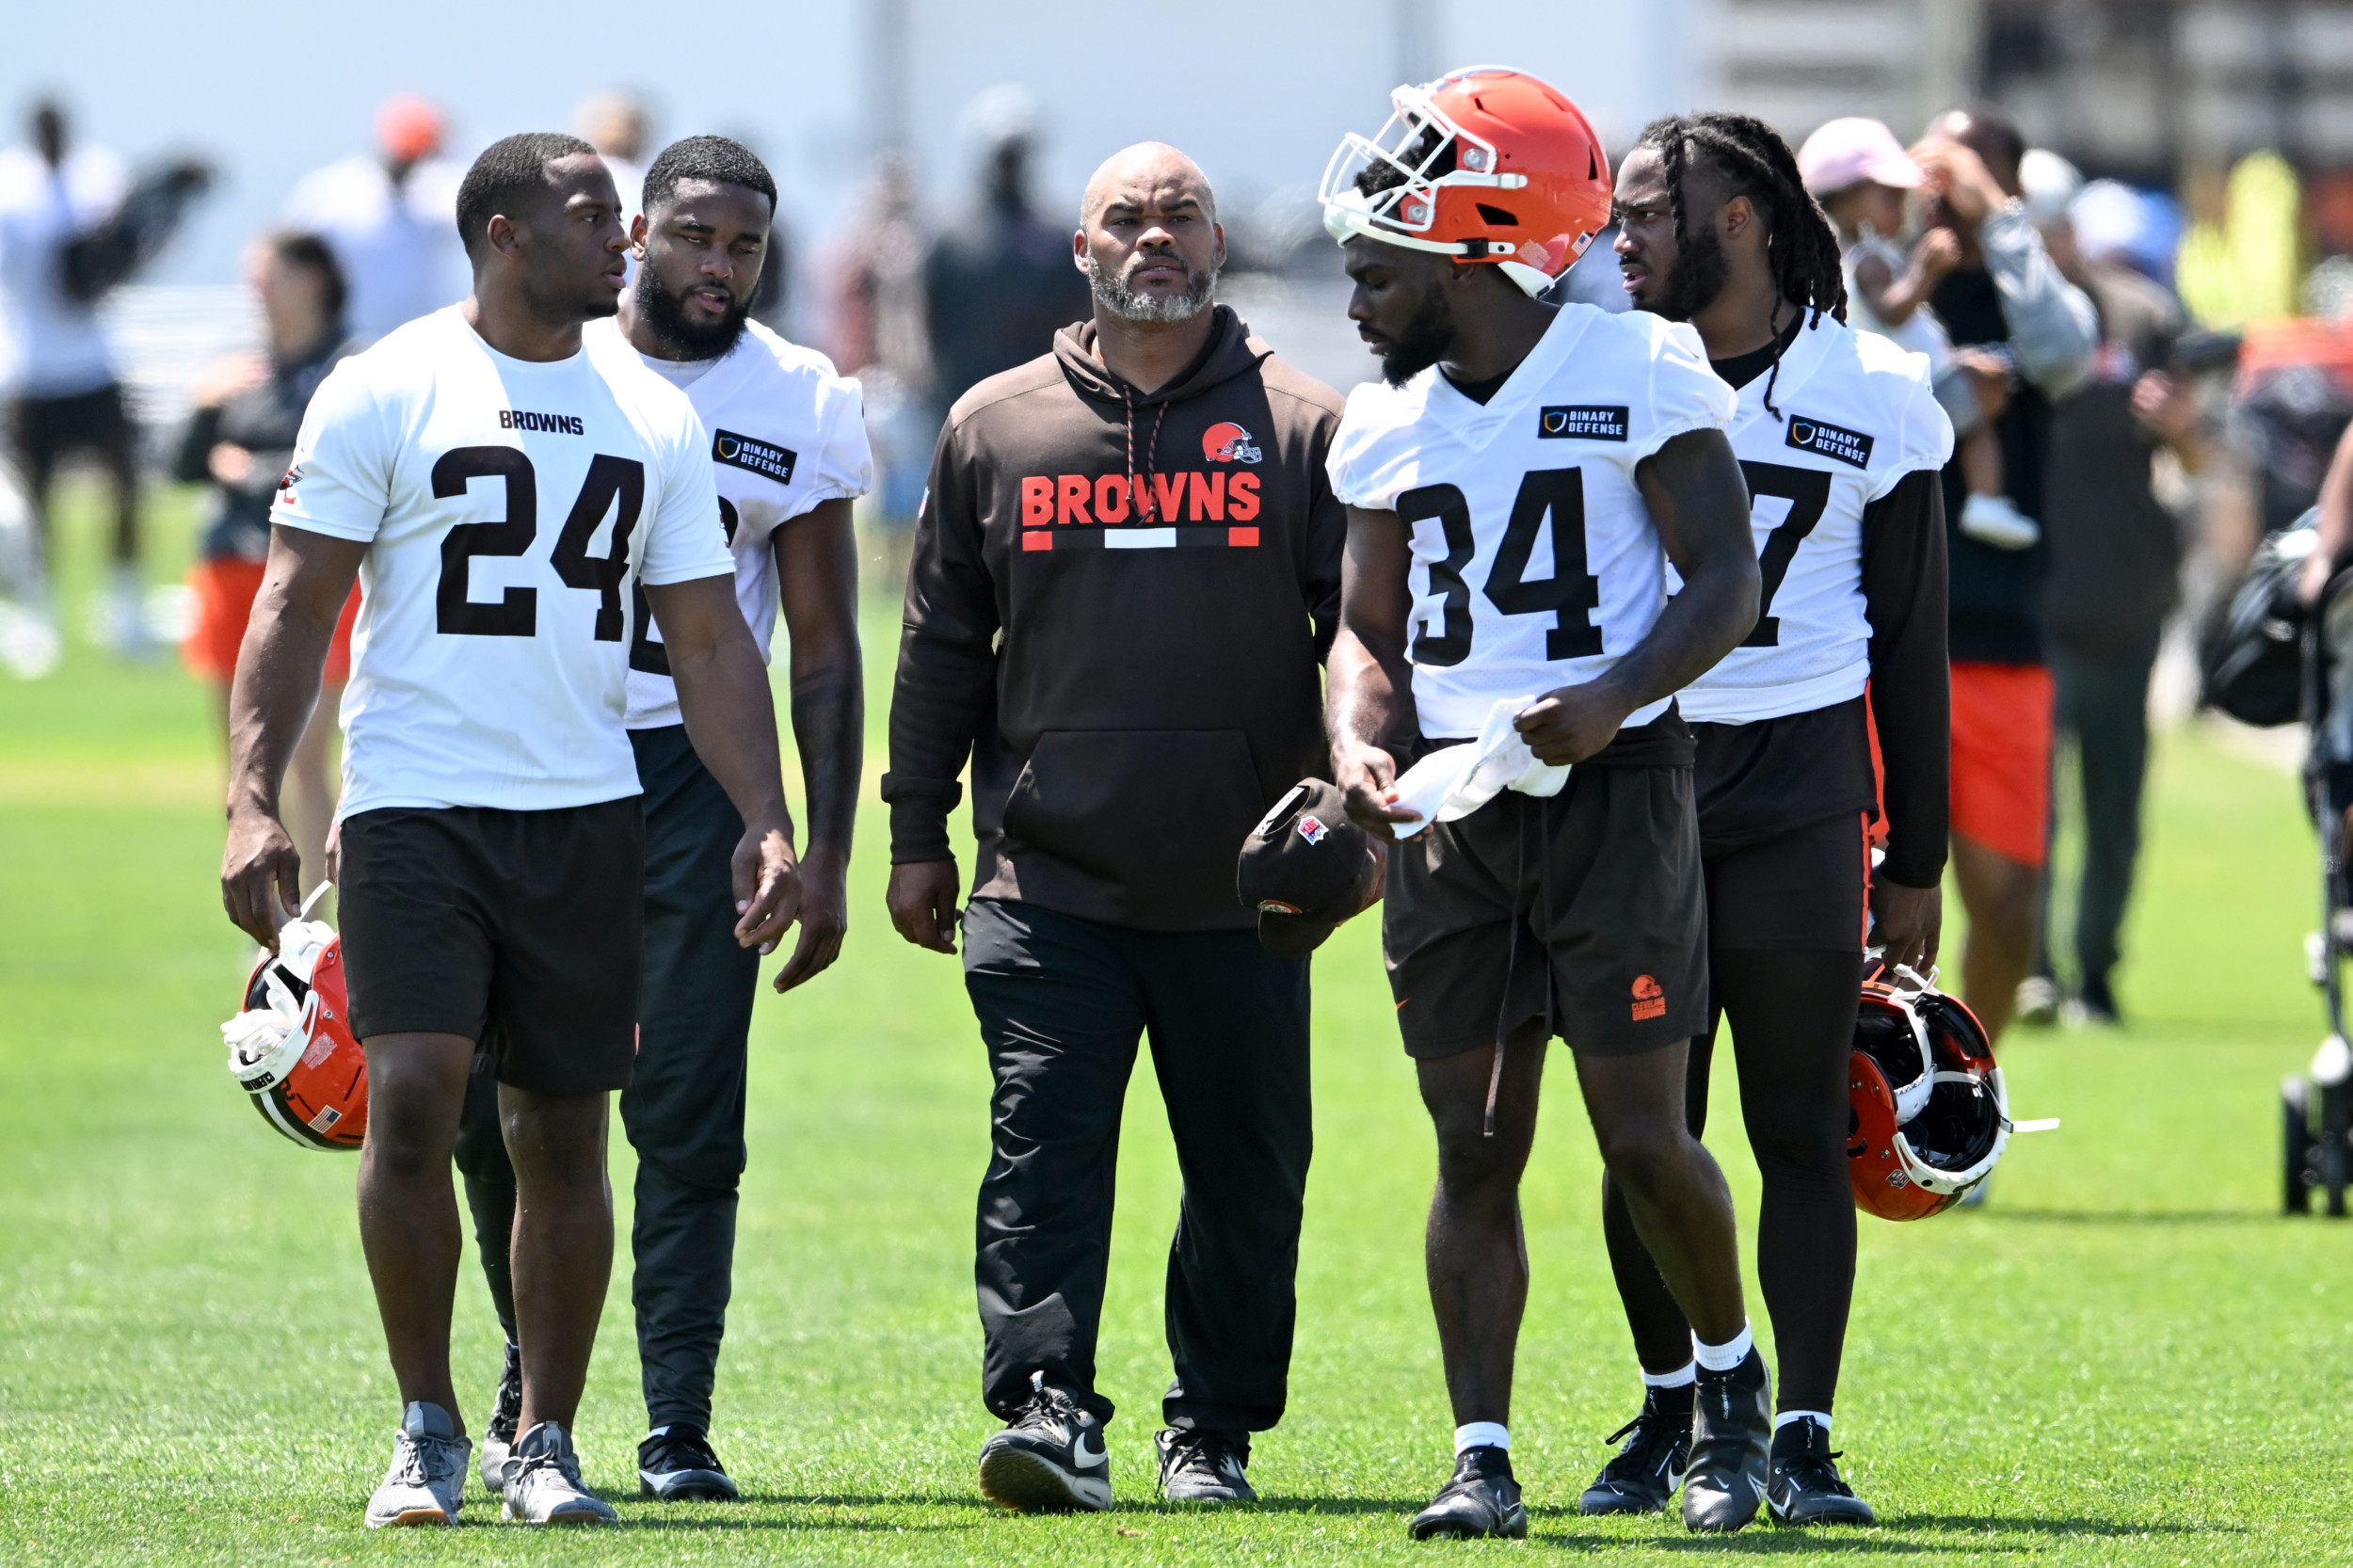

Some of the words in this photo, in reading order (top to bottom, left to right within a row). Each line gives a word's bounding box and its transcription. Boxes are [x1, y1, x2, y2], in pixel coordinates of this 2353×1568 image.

[499, 409, 584, 436] BROWNS
[1568, 422, 1623, 435] DEFENSE
[1569, 410, 1614, 423] BINARY
[1817, 426, 1861, 447] BINARY
[743, 441, 784, 462] BINARY
[1815, 438, 1866, 463] DEFENSE
[740, 453, 789, 478] DEFENSE
[1022, 472, 1260, 526] BROWNS
[431, 446, 645, 642] 24
[1396, 466, 1605, 666] 34
